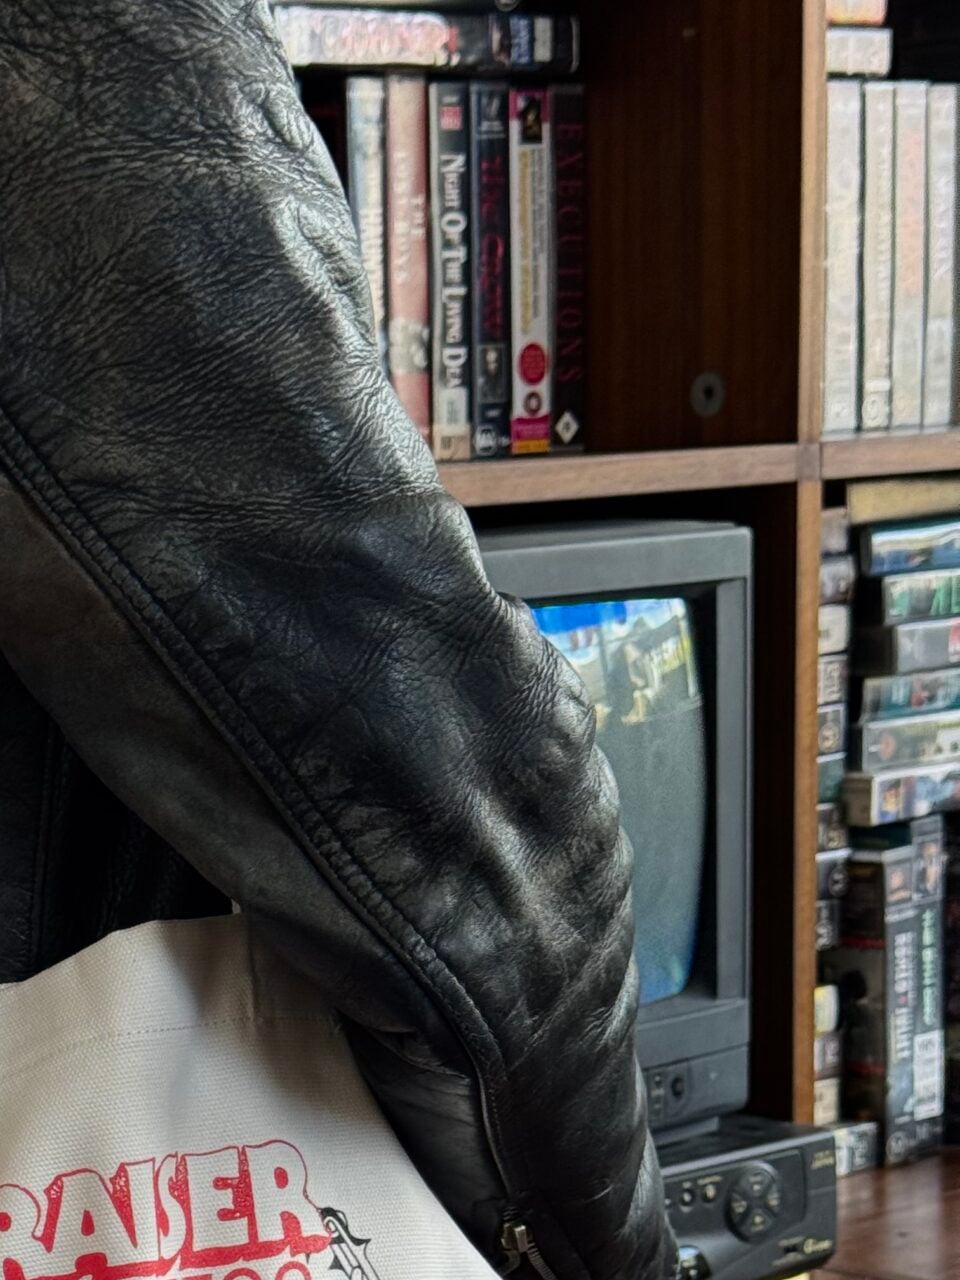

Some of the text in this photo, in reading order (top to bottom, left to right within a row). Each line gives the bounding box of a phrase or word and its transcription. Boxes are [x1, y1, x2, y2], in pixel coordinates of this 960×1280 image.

[440, 154, 466, 207] NIGHT
[441, 211, 467, 245] OF
[556, 121, 584, 385] EXECUTIONS
[442, 247, 467, 284] THE
[441, 286, 467, 343] LIVING
